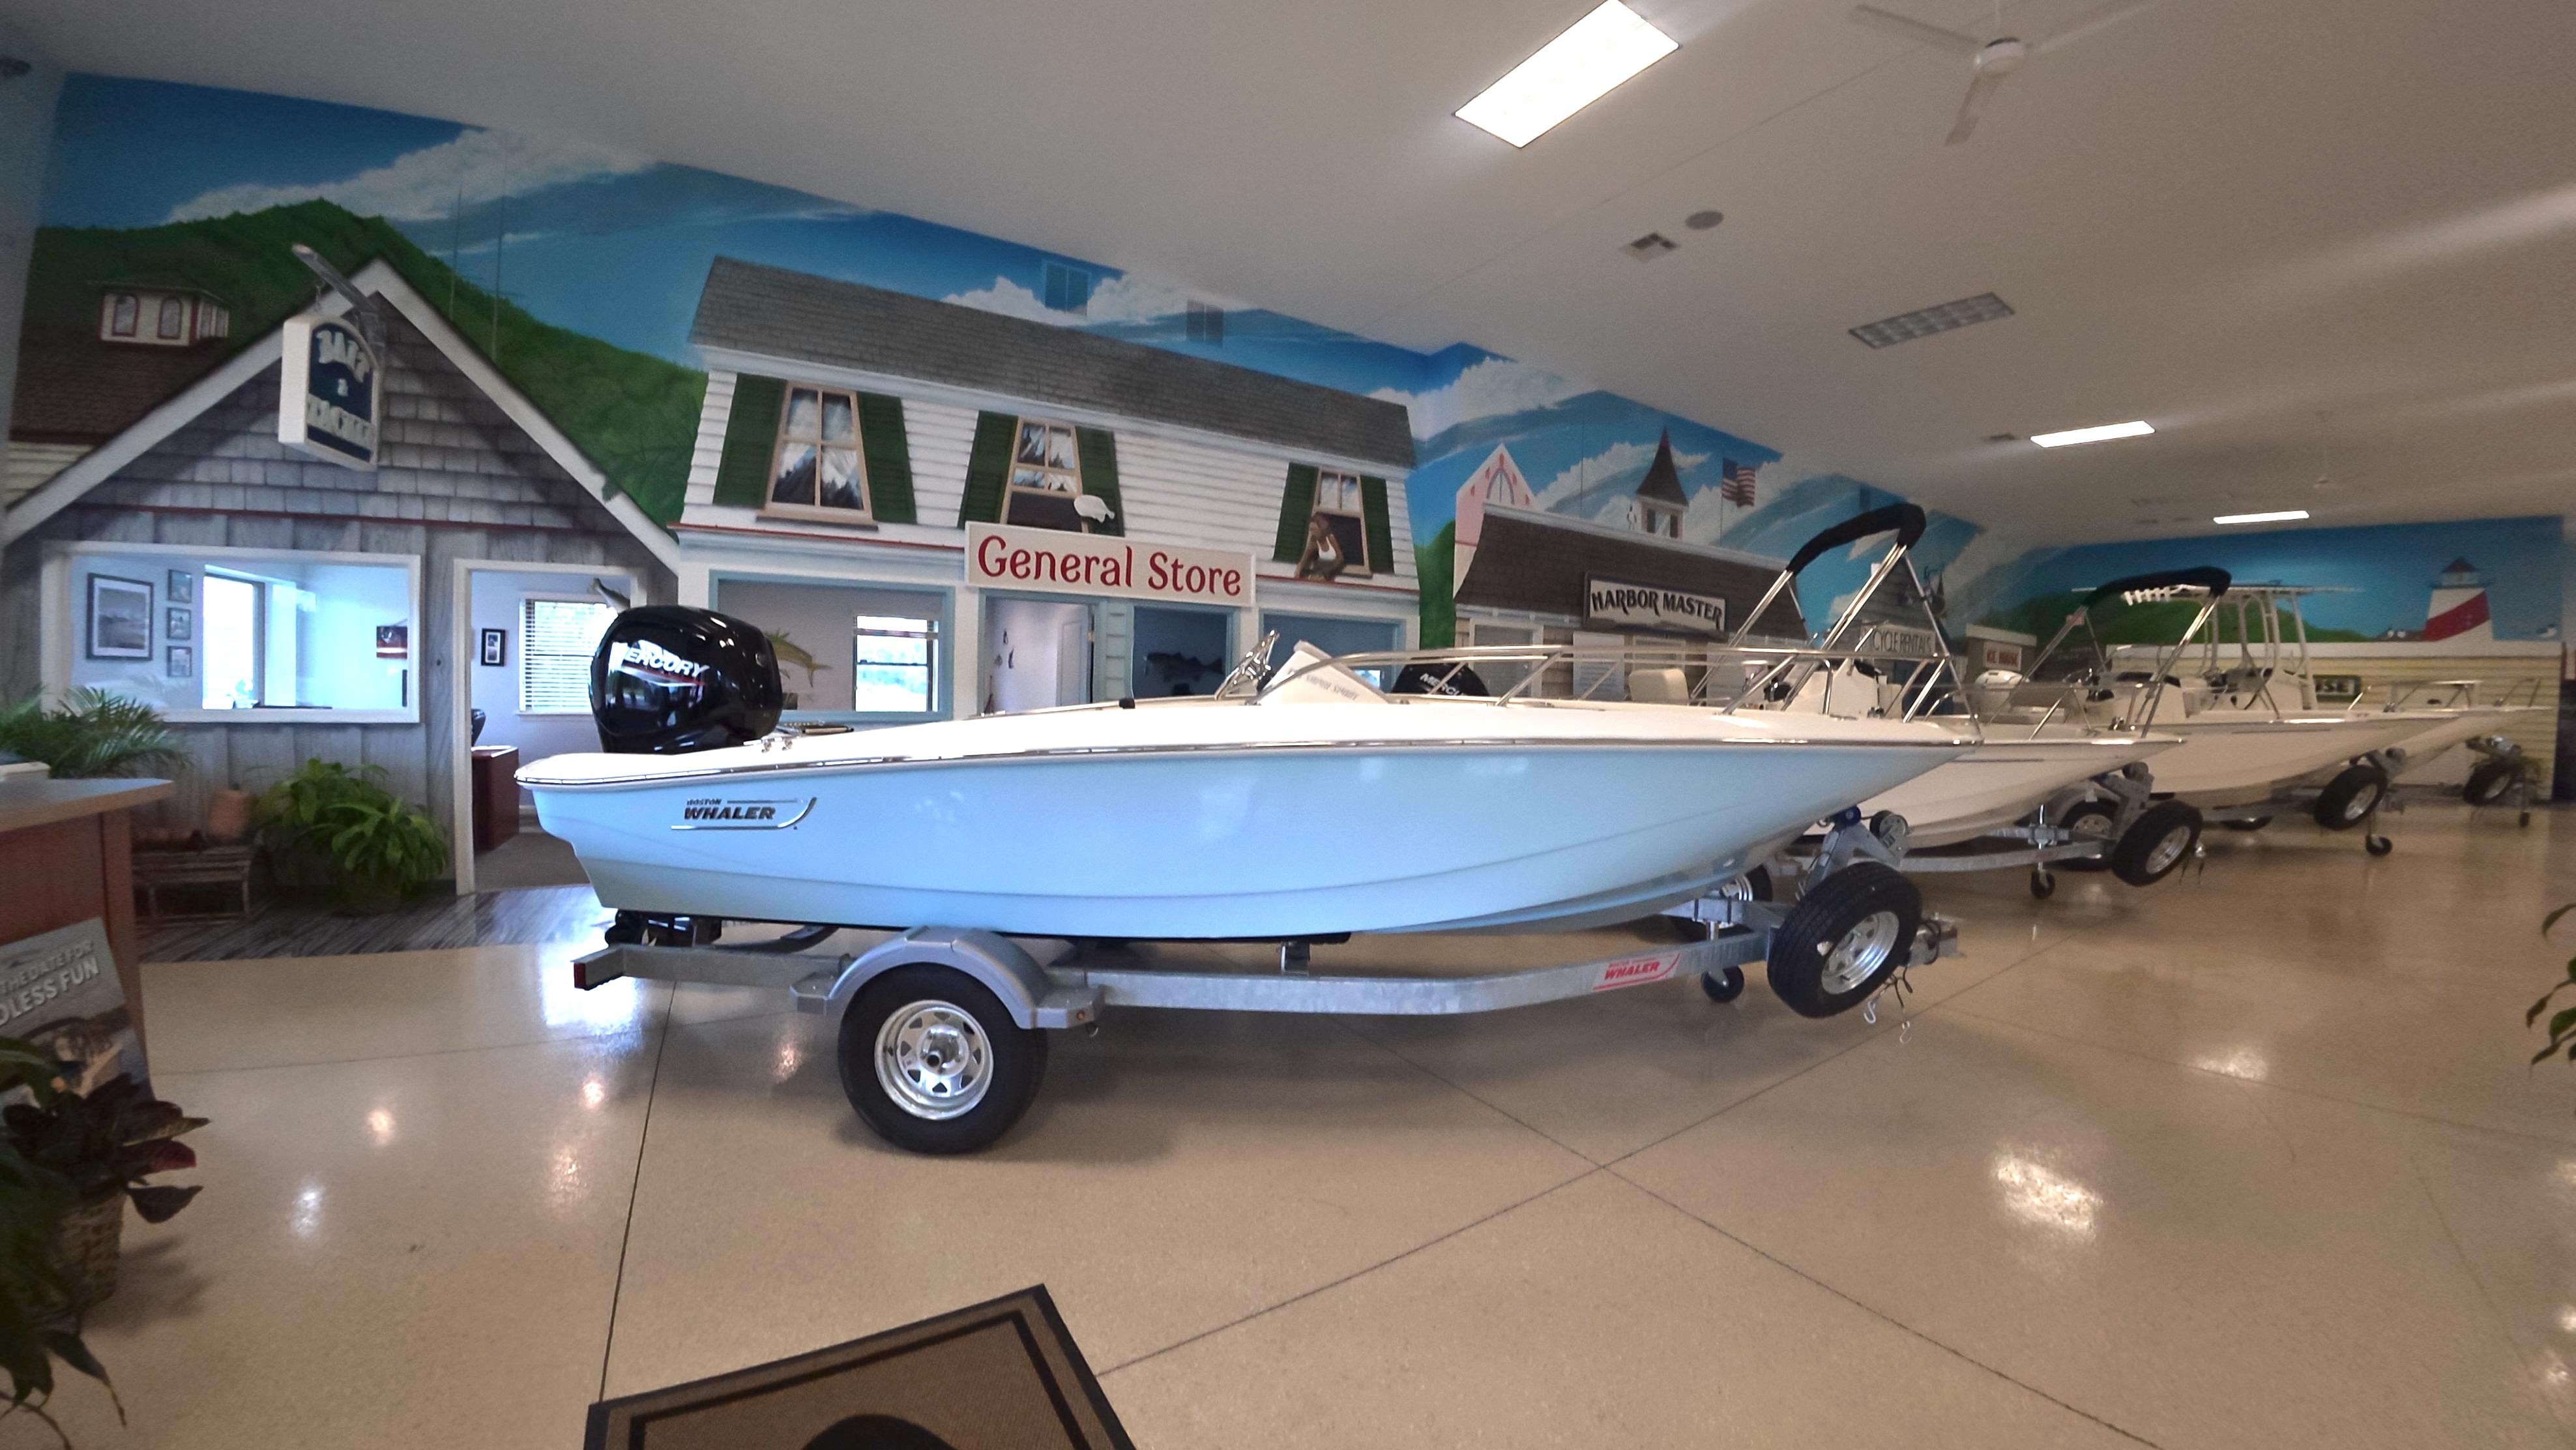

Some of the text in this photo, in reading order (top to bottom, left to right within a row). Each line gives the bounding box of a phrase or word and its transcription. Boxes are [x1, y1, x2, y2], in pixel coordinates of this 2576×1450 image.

[978, 535, 1242, 596] General Store
[1591, 589, 1723, 631] HARBOR MASTER
[1865, 629, 1932, 653] CYCLE RENTALS
[684, 806, 776, 820] WHALER
[59, 955, 100, 992] FUN
[1604, 961, 1661, 980] WHALER
